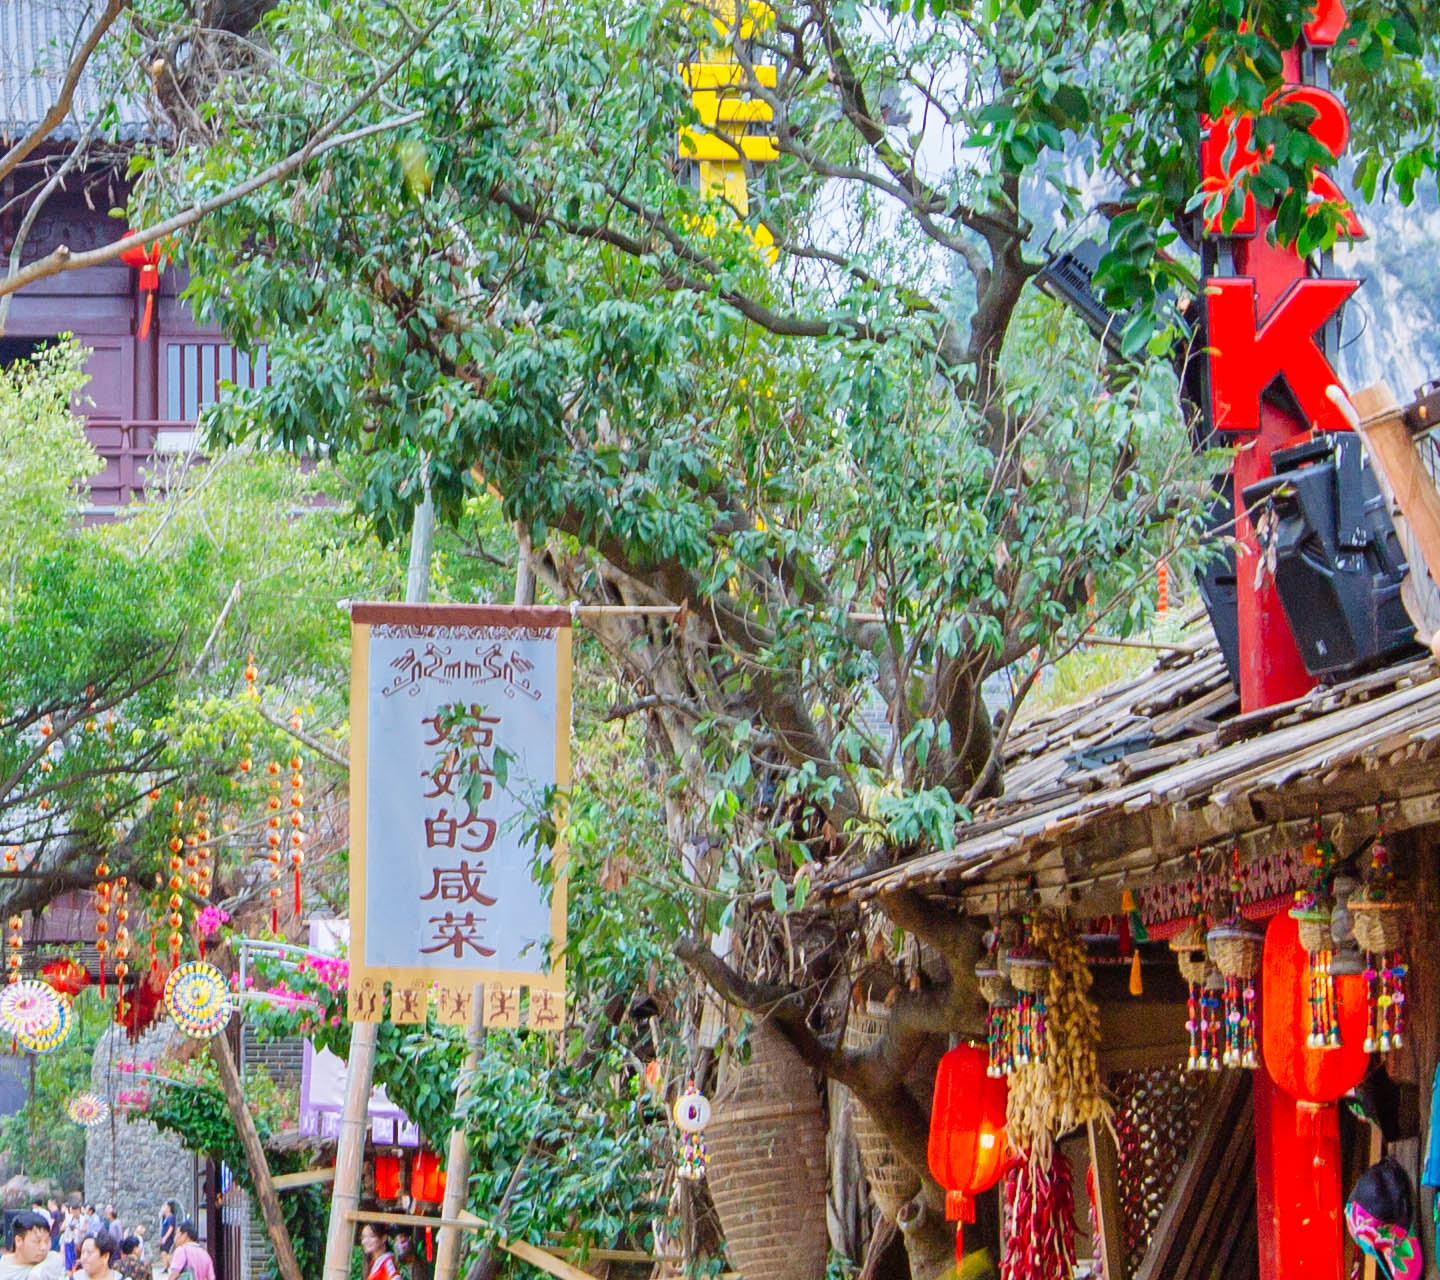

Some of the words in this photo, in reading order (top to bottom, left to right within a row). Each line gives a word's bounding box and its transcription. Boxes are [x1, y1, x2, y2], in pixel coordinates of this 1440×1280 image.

[419, 704, 501, 958] 姑姑的咸菜
